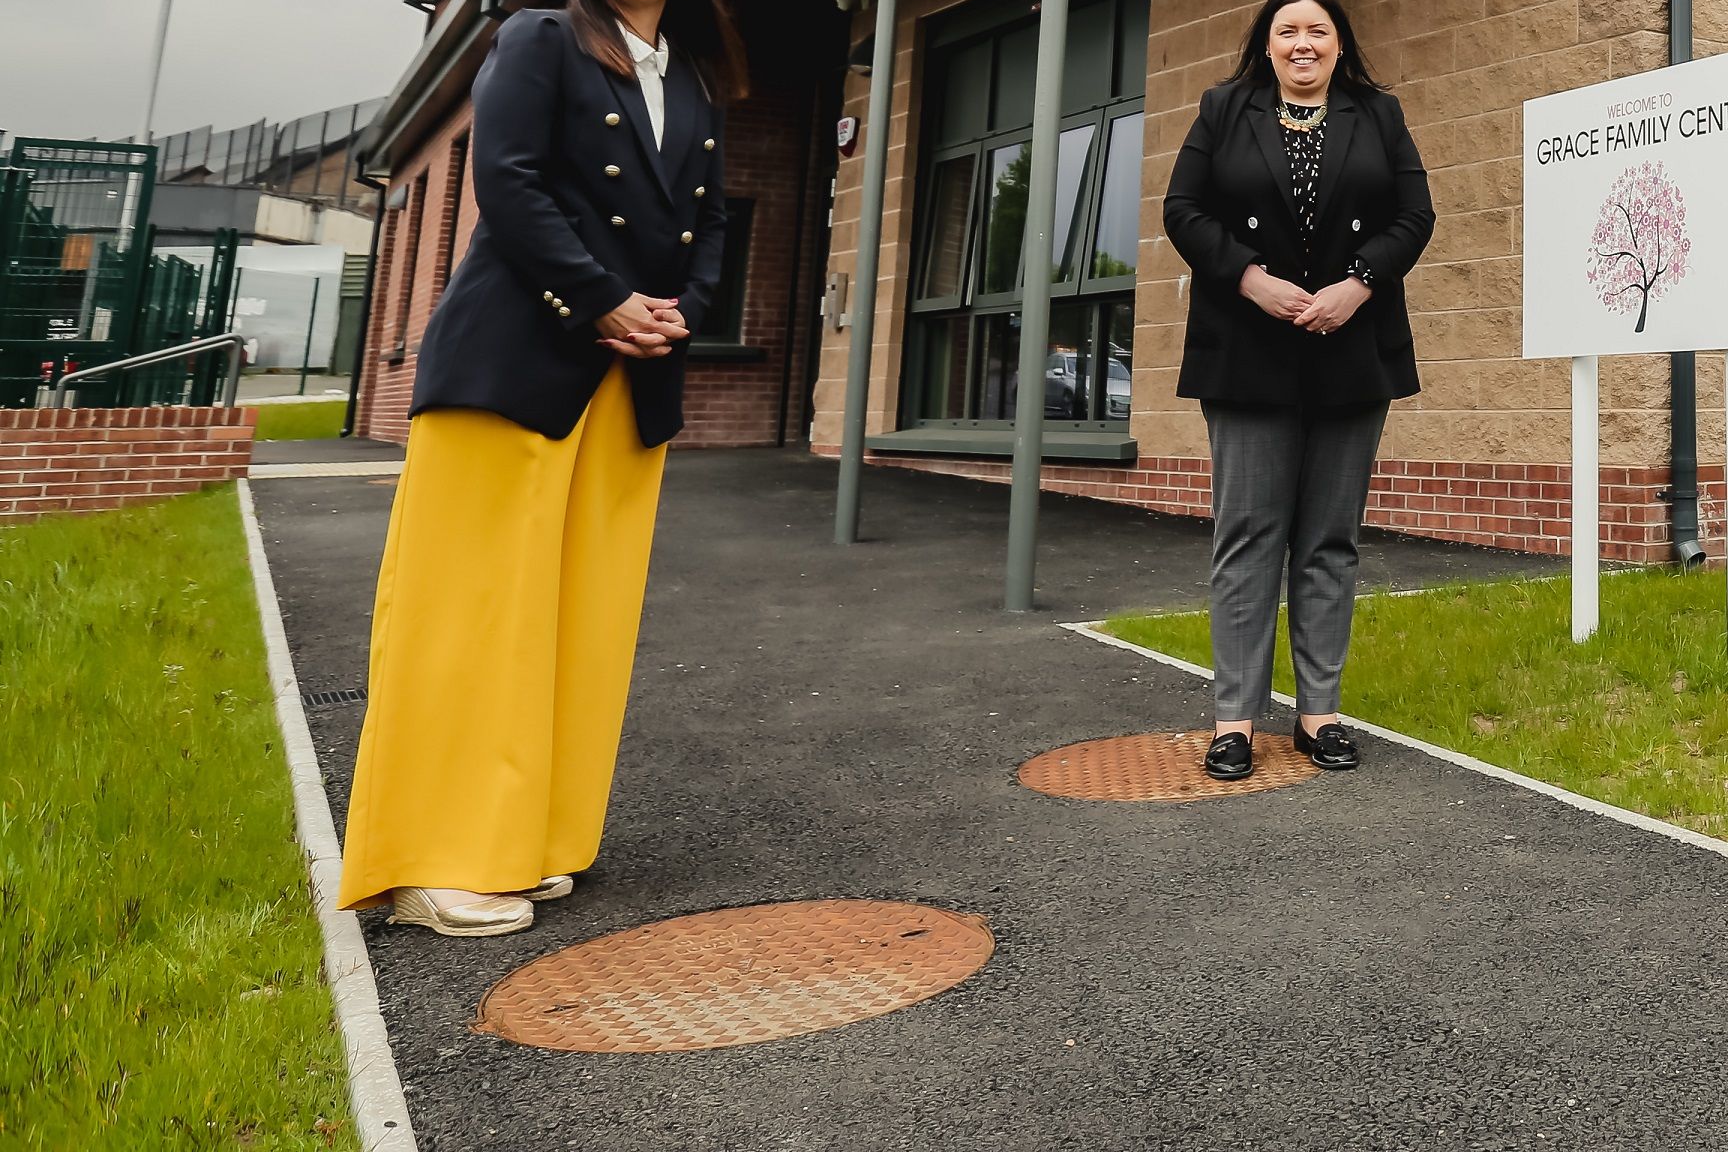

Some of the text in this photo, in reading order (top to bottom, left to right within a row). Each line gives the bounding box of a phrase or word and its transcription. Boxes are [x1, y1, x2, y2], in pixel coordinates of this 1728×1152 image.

[1607, 92, 1673, 120] WELCOME TO
[1537, 128, 1599, 165] GRACE
[1606, 114, 1672, 153] FAMILY
